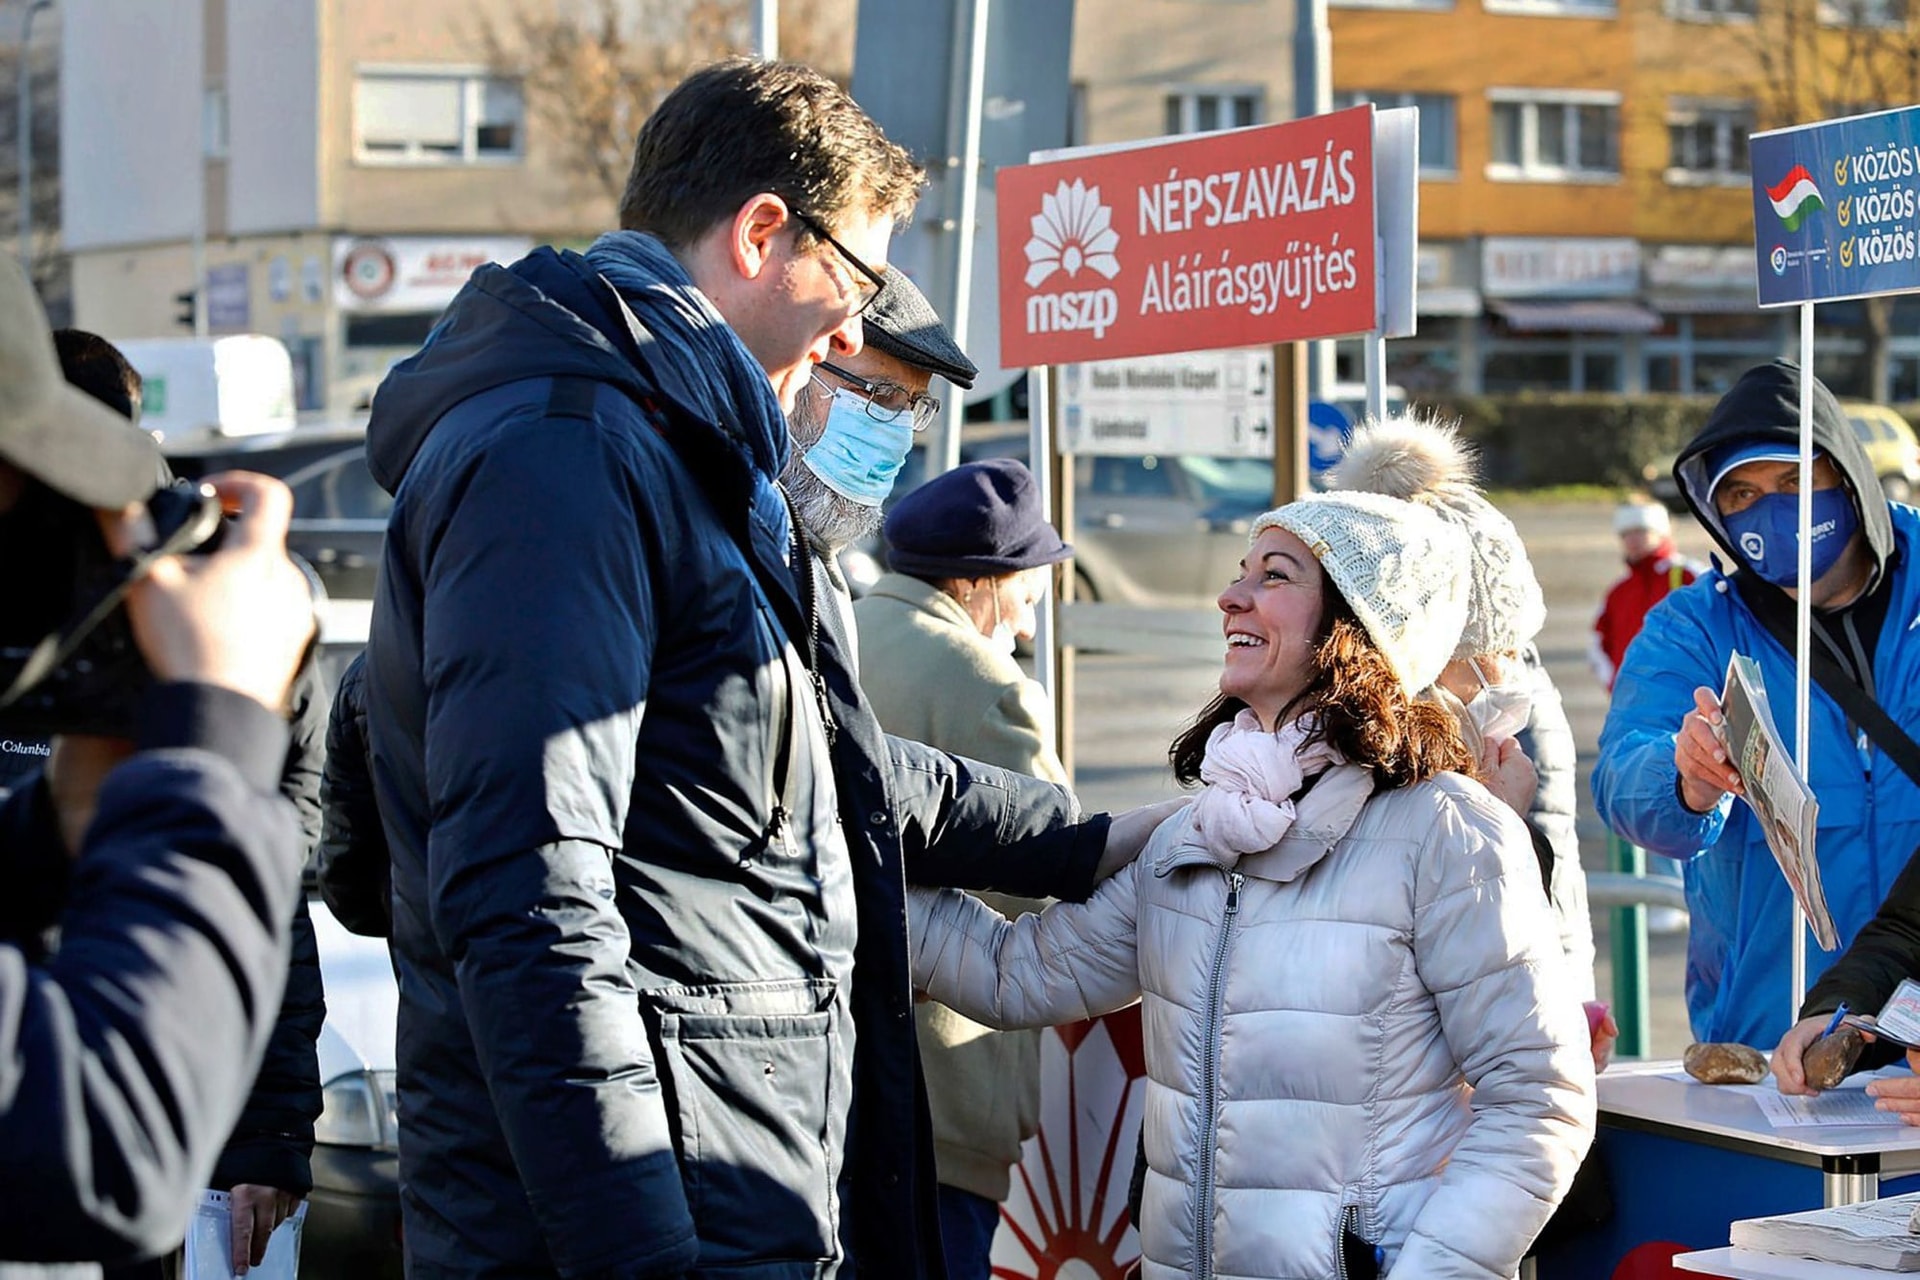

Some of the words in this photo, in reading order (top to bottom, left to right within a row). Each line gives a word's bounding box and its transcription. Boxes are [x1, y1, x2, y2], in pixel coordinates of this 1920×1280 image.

[1852, 142, 1913, 184] KÖZÖS
[1138, 140, 1355, 235] NÉPSZAVAZÁS
[1856, 183, 1914, 225] KÖZÖS
[1858, 225, 1915, 266] KÖZÖS
[1140, 233, 1357, 317] Aláírásgyűjtés
[1026, 287, 1118, 339] mszp
[2, 739, 51, 756] Columbia
